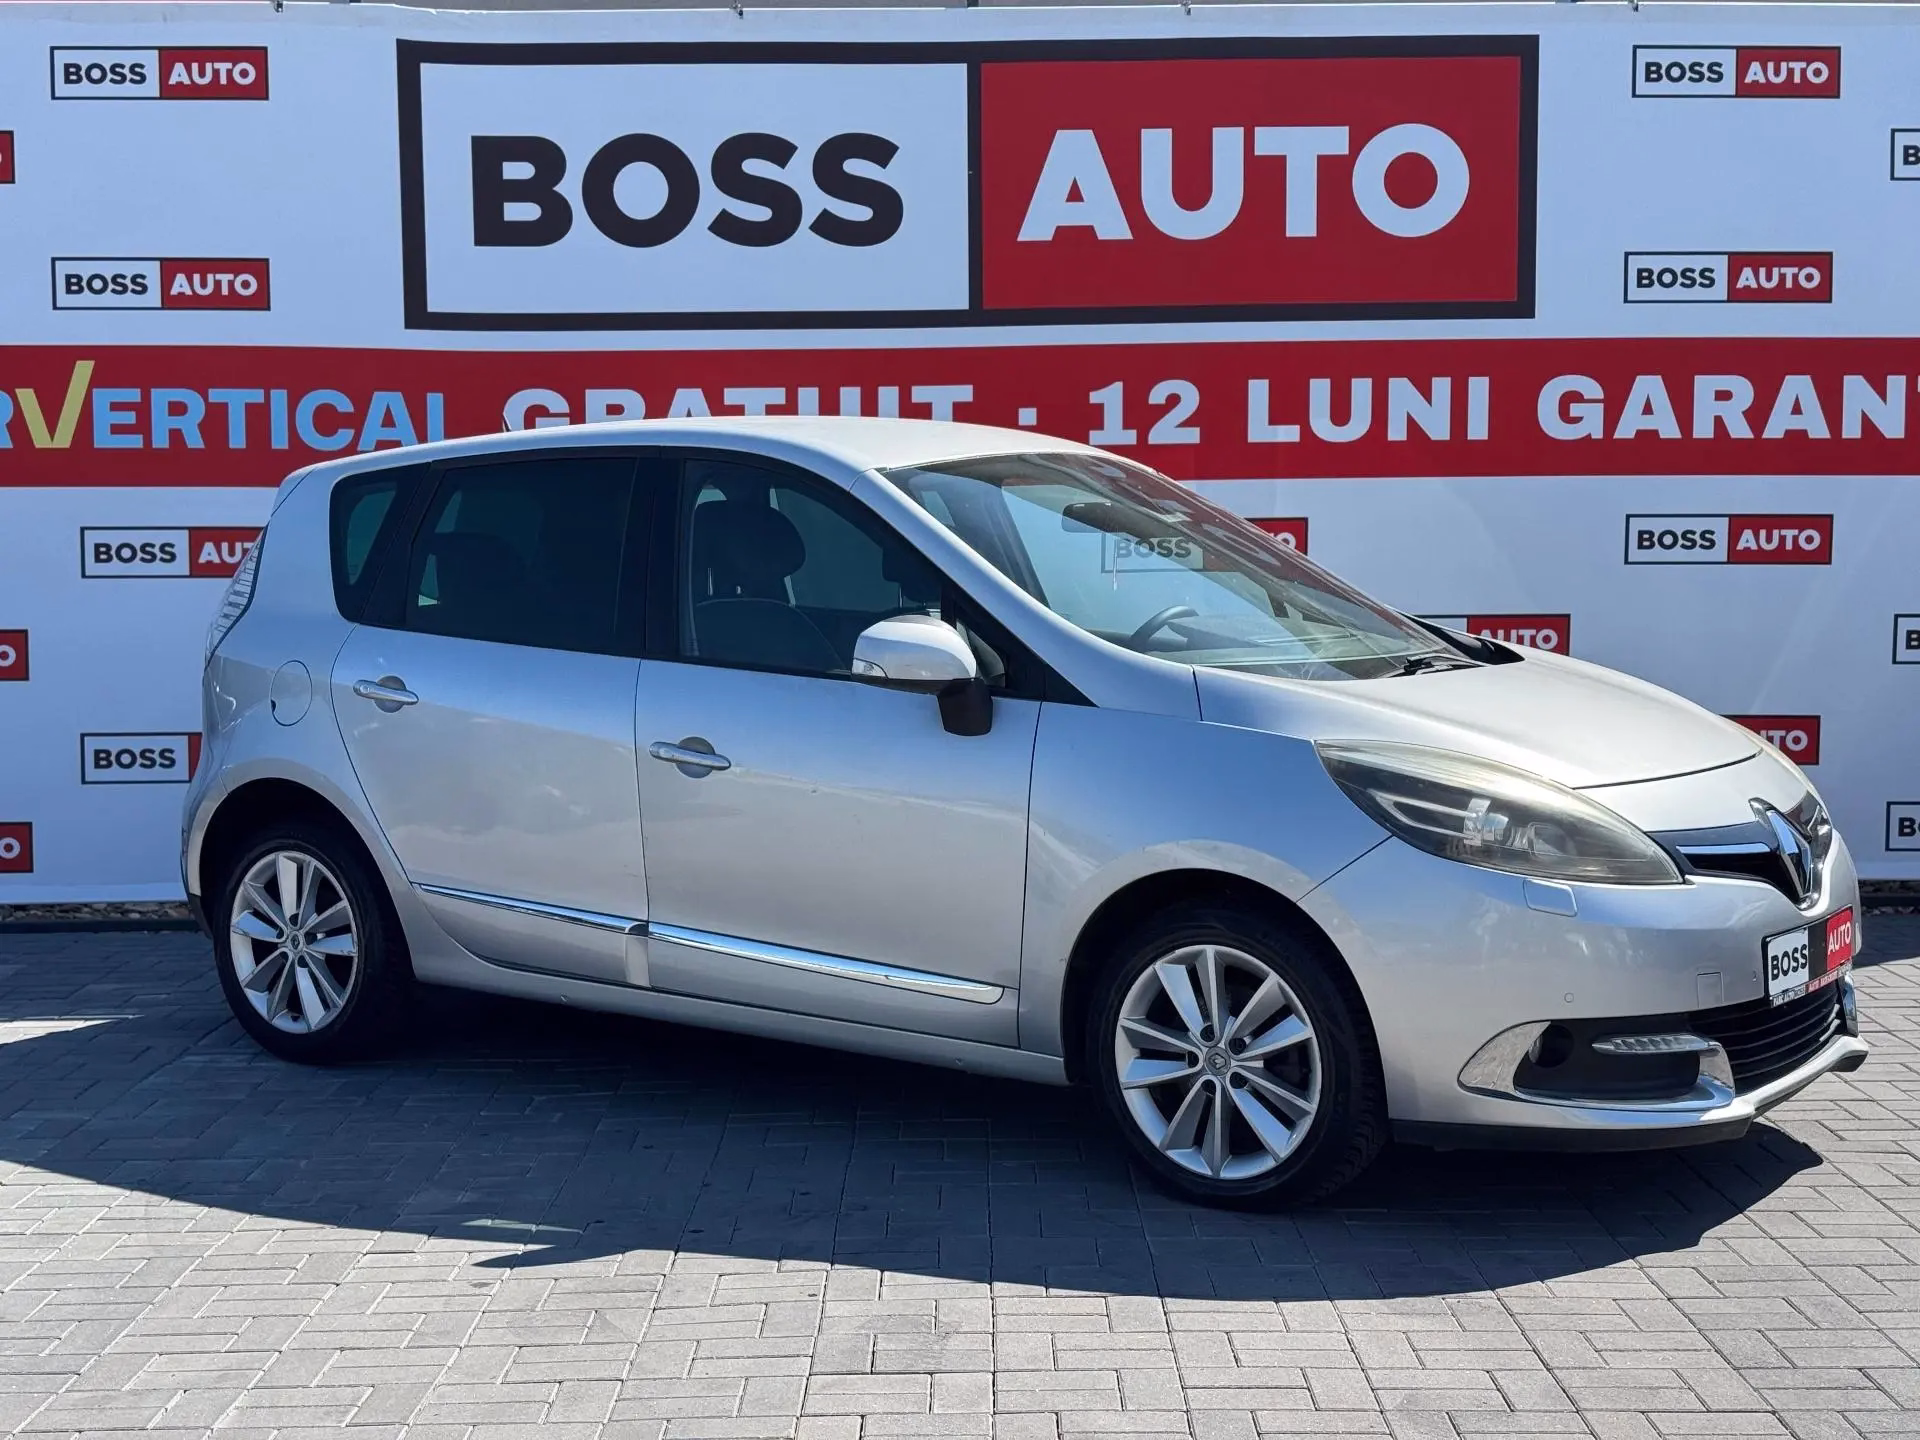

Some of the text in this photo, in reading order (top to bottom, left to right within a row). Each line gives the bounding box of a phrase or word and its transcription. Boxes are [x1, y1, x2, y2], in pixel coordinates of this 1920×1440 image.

[64, 62, 256, 85] BOSS AUTO
[1644, 62, 1829, 84] BOSS AUTO
[471, 123, 1470, 248] BOSS AUTO
[65, 274, 258, 296] BOSS AUTO
[1636, 267, 1821, 289] BOSS AUTO
[1089, 379, 1200, 445] 12
[1247, 376, 1490, 443] LUNI
[1537, 374, 1920, 440] GARAN
[1117, 538, 1192, 559] BOSS
[1637, 529, 1821, 551] BOSS AUTO
[93, 542, 176, 563] BOSS
[1760, 730, 1808, 751] TO
[93, 748, 176, 769] BOSS
[1771, 943, 1807, 981] BOSS
[1827, 921, 1852, 955] AUTO
